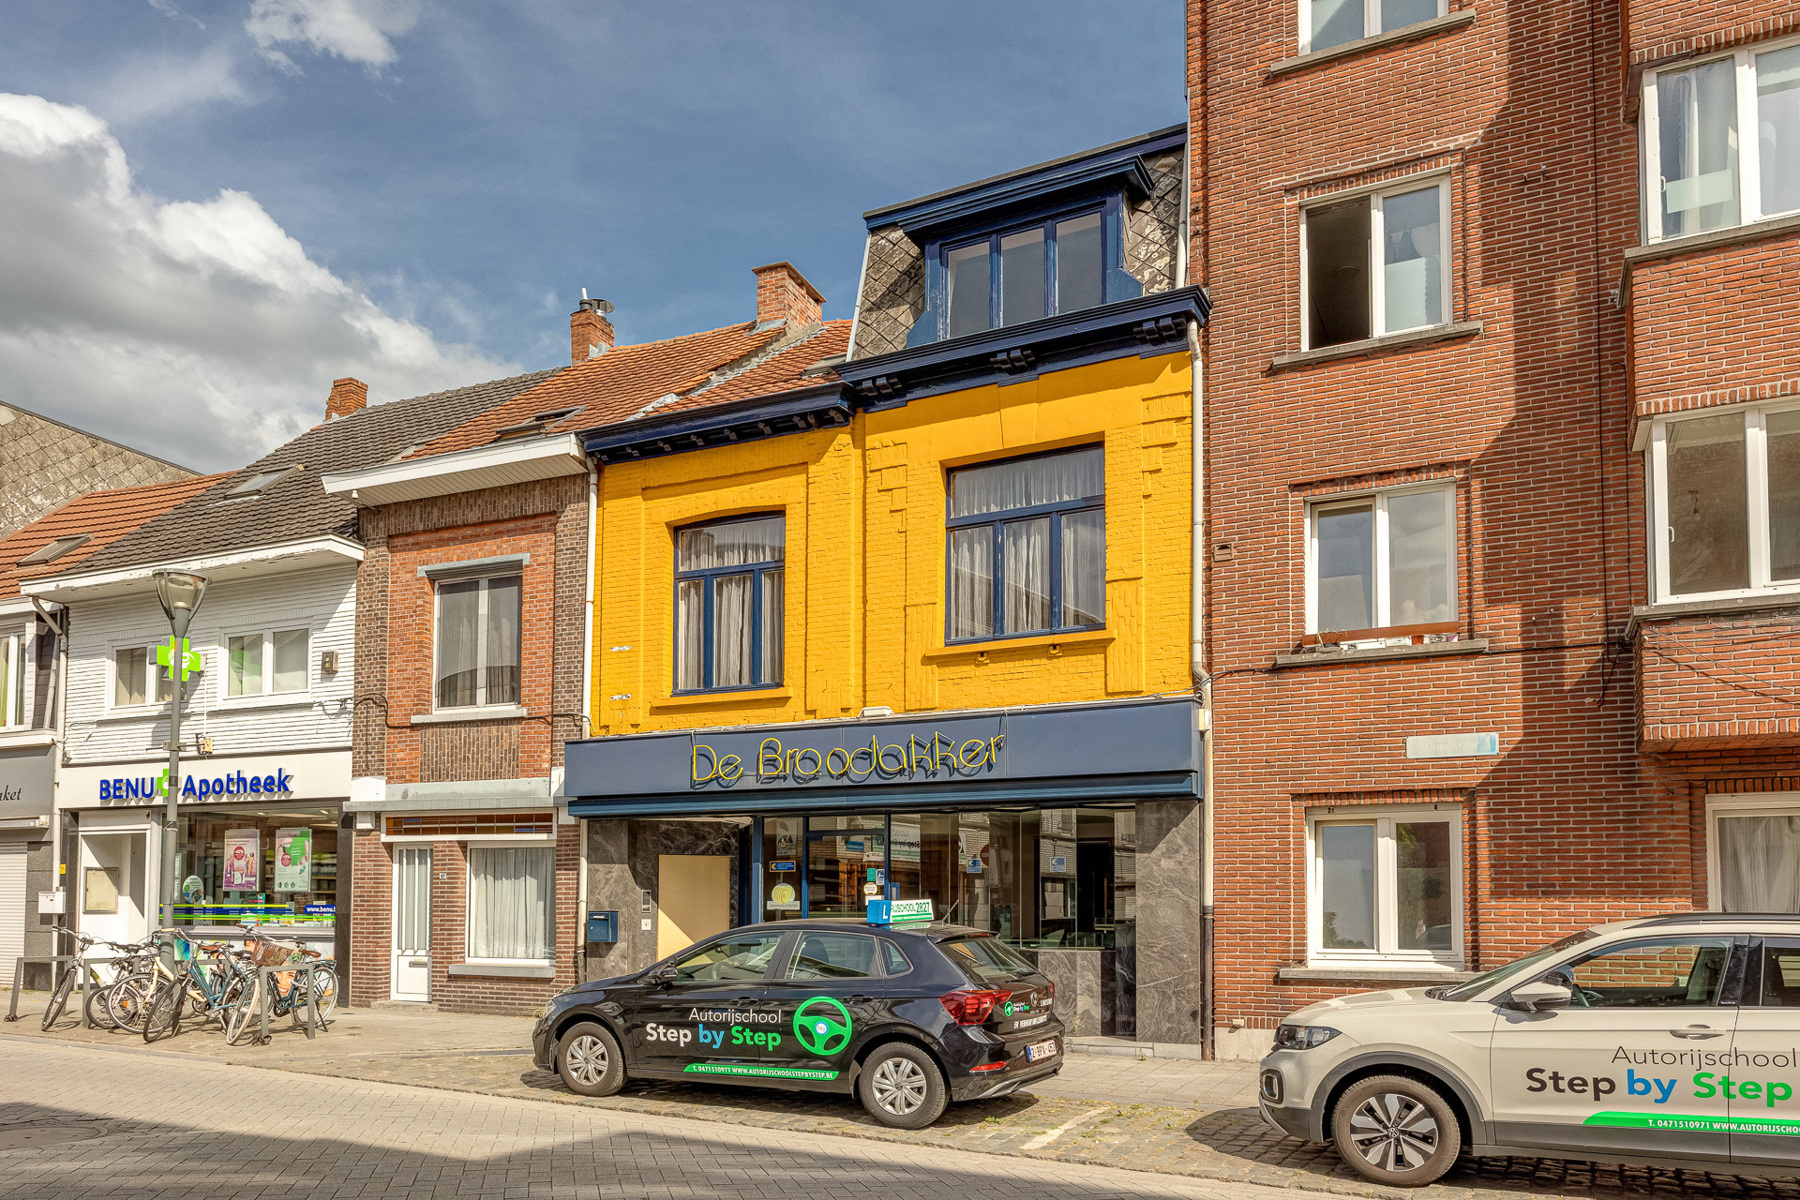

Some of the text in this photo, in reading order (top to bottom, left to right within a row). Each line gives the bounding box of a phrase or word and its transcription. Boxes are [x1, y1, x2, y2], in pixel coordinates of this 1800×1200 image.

[692, 731, 1005, 781] De Broodakker
[100, 767, 290, 801] BENU Apotheek
[882, 904, 889, 919] L
[915, 902, 930, 913] 2827
[689, 1007, 782, 1026] Autorijschool
[645, 1023, 782, 1051] Step by Step
[1611, 1045, 1797, 1071] Autorijschool
[1525, 1067, 1793, 1108] Step by Step
[1648, 1119, 1800, 1133] T. 0471510971 WWW.AUTORIJSCHO
